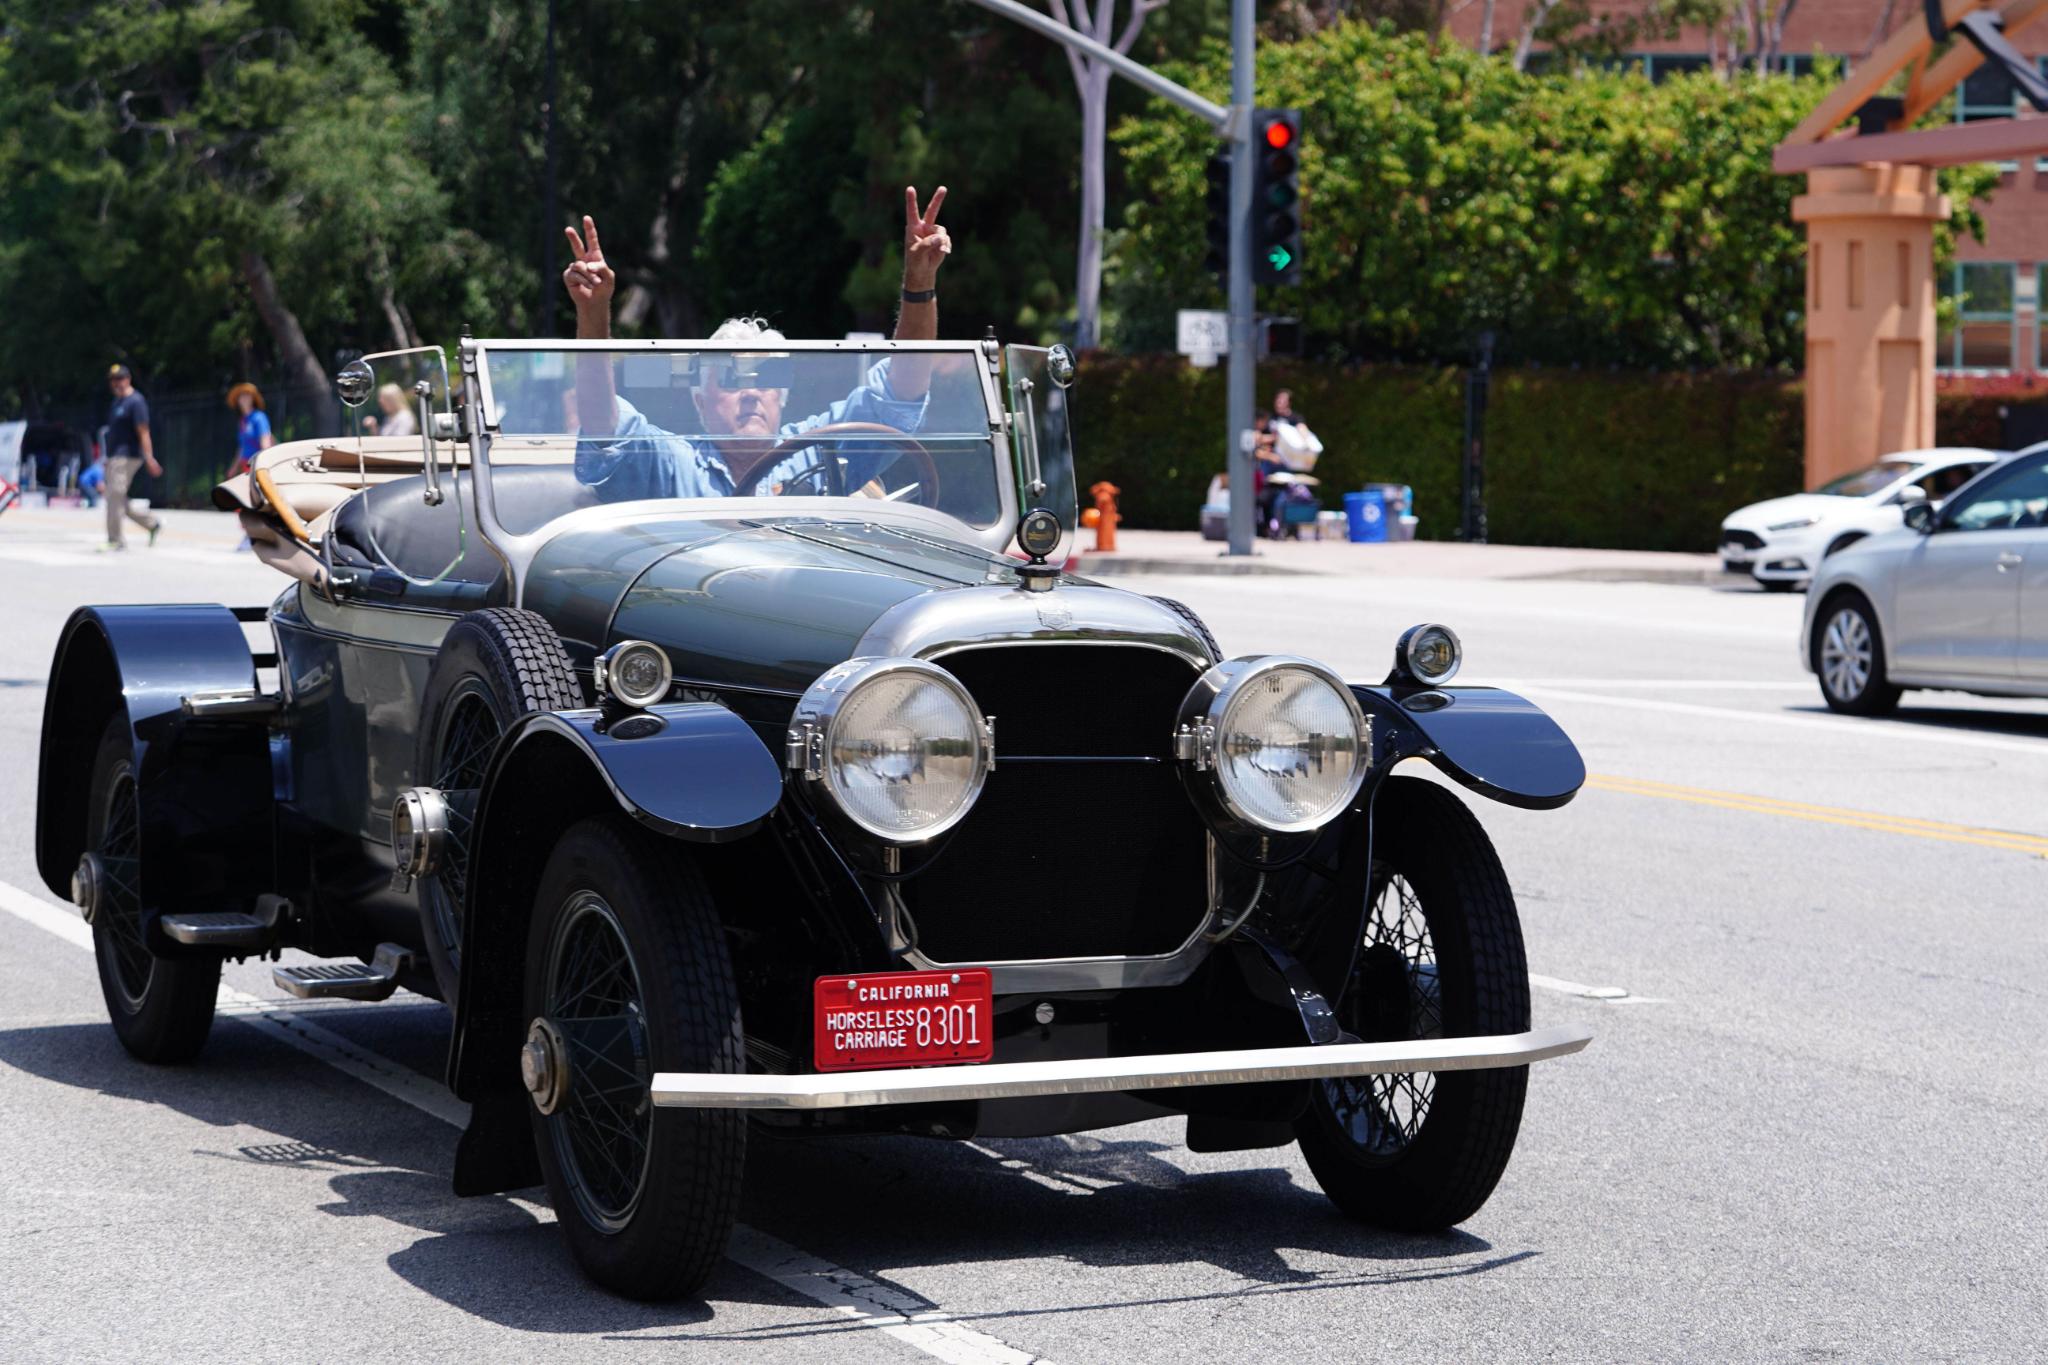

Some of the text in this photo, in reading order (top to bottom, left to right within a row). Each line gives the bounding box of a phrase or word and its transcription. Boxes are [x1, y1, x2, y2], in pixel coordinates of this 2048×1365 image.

[859, 984, 949, 1001] CALIFORNIA
[827, 1009, 915, 1030] HORSELESS
[916, 1004, 981, 1047] 8301
[835, 1029, 907, 1050] CARRIAGE
